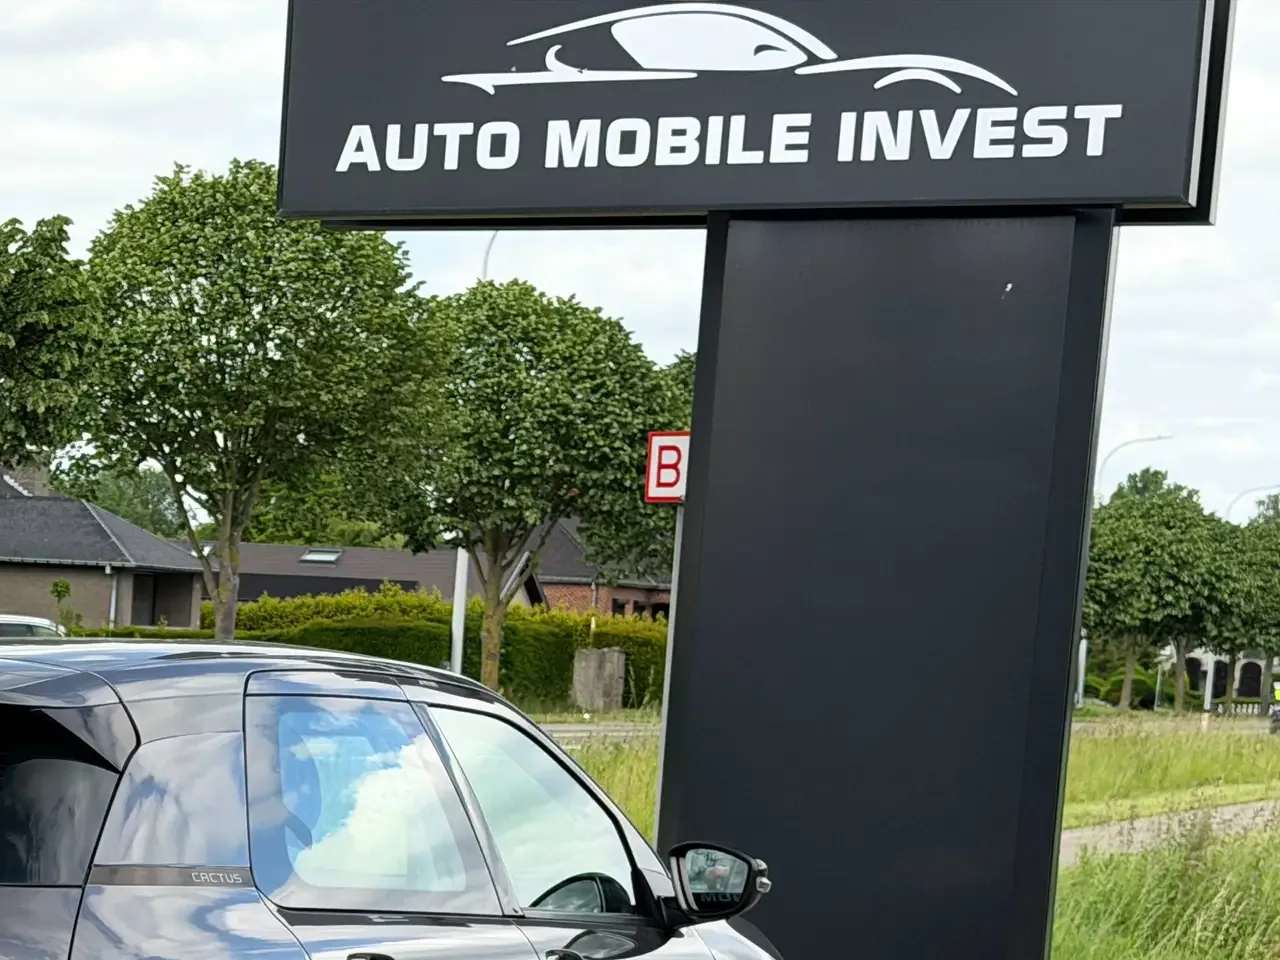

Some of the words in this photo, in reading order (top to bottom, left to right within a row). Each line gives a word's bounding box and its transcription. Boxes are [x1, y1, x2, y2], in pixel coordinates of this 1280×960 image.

[335, 121, 521, 172] AUTO
[544, 113, 812, 169] MOBILE
[837, 104, 1123, 162] INVEST
[656, 444, 682, 488] B
[191, 871, 243, 884] CACTUS
